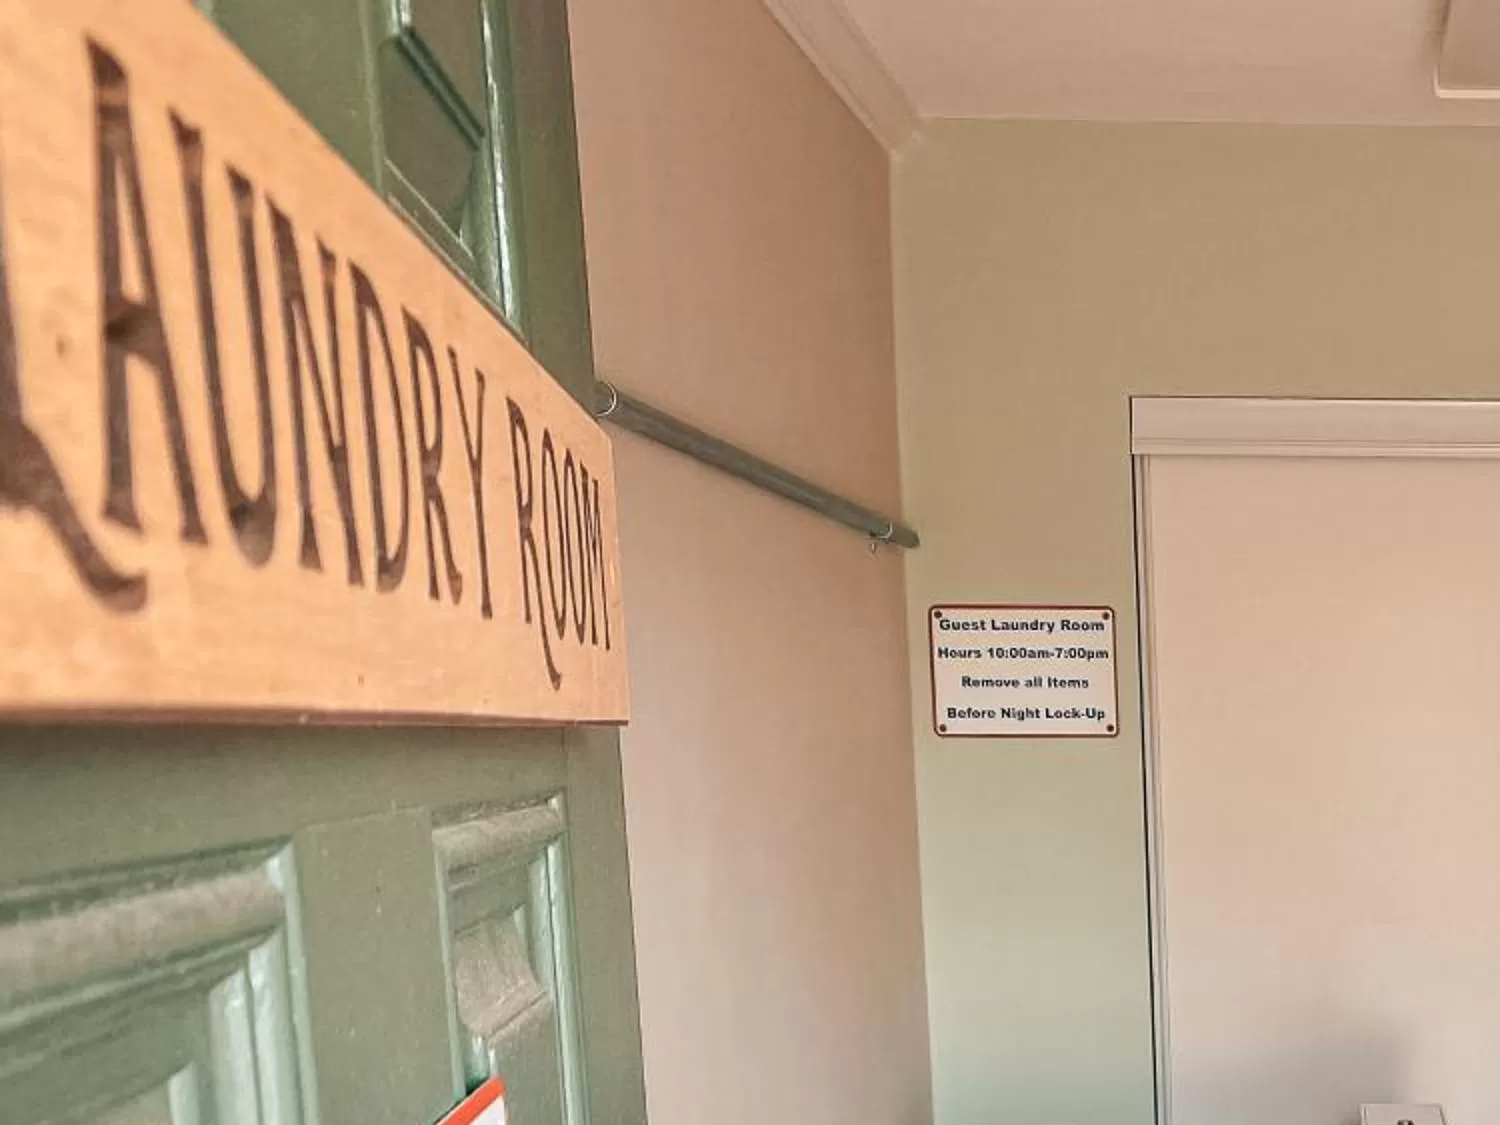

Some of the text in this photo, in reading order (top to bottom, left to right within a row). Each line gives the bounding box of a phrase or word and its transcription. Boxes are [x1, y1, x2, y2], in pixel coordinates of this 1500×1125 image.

[505, 395, 611, 691] ROOM
[938, 619, 1106, 634] Guest Laundry Room
[937, 647, 1109, 662] Hours 10:00am-7:00pm
[961, 676, 1090, 688] Remove all Items
[947, 707, 1106, 721] Before Night Lock-Up
